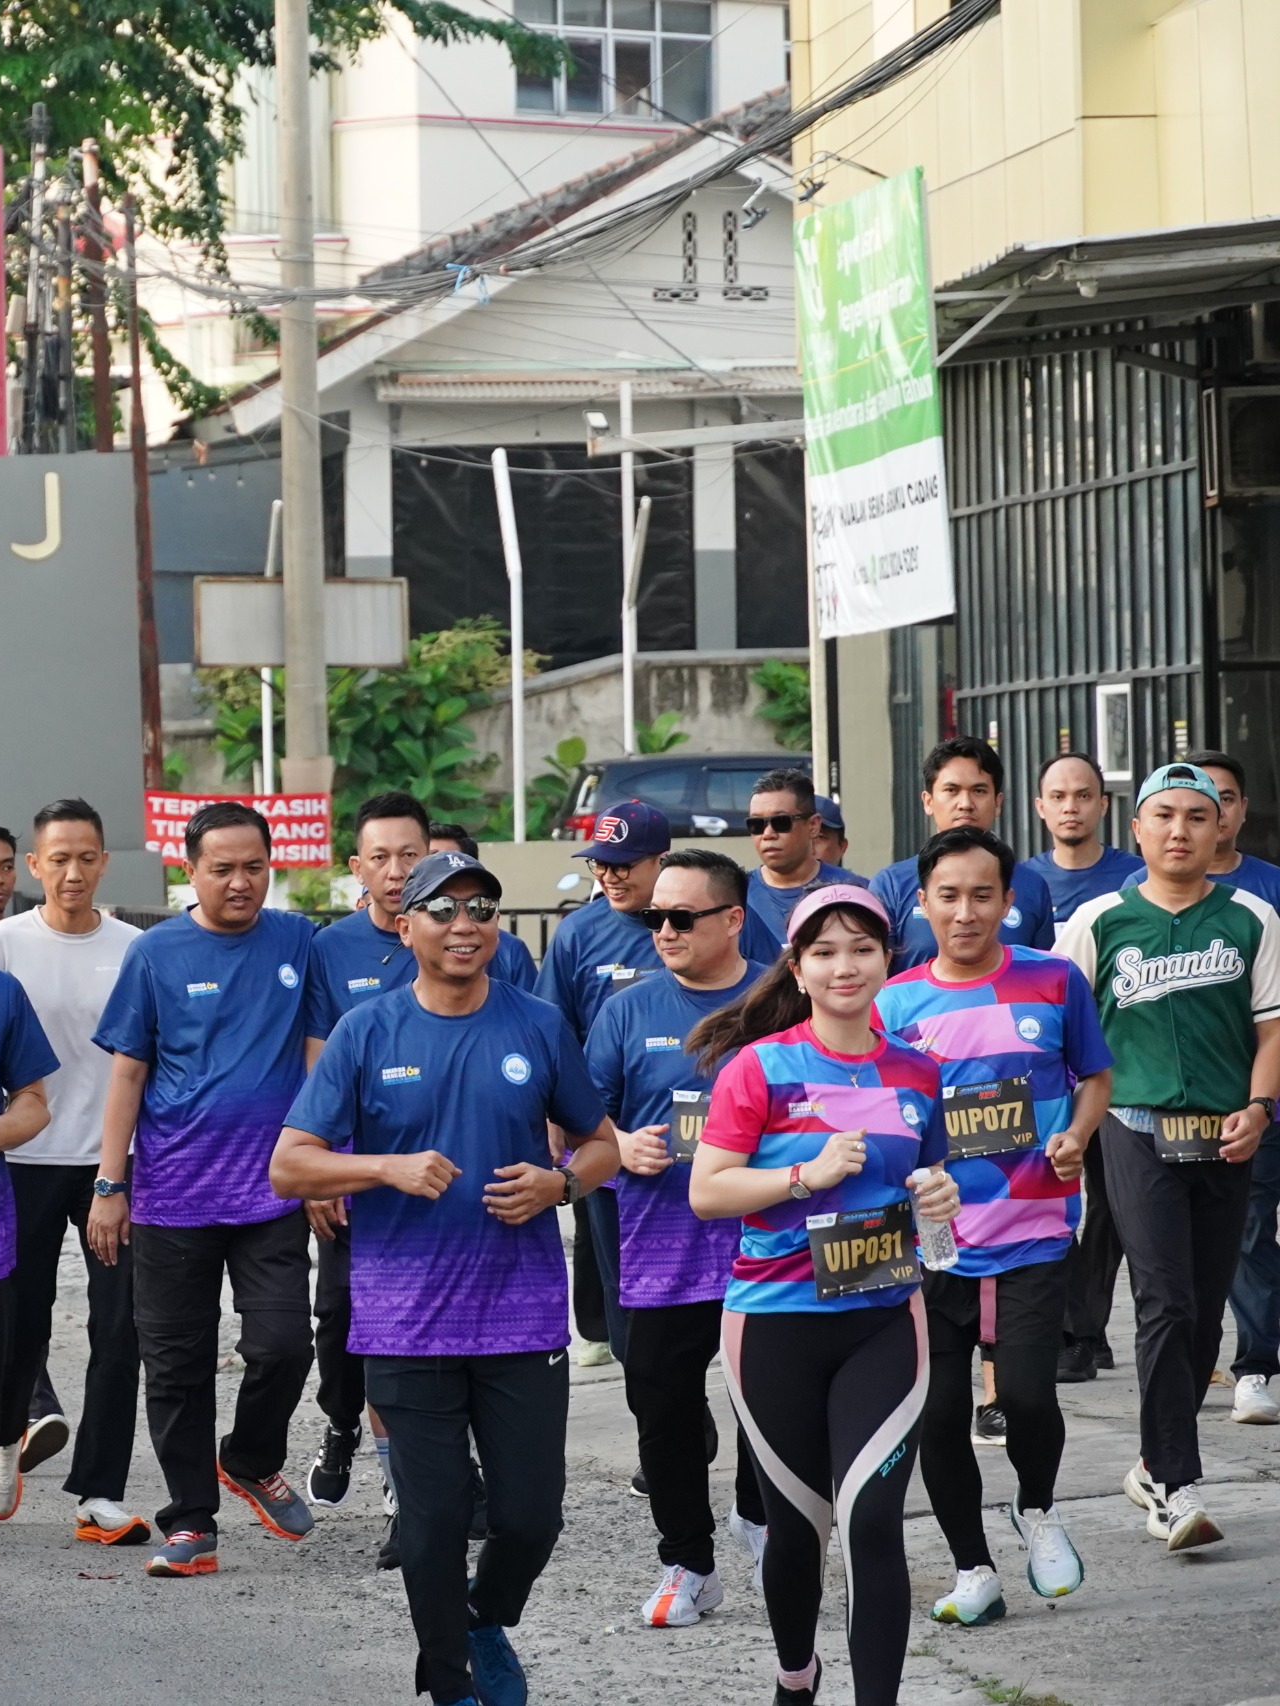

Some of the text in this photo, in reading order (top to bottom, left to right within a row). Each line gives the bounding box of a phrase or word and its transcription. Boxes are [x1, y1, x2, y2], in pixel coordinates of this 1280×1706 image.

[10, 471, 62, 561] J
[252, 799, 327, 816] KASIH
[268, 822, 326, 839] ANG
[446, 853, 466, 868] LA
[1113, 939, 1242, 1000] Smanda
[944, 1100, 1023, 1137] VIP077
[1012, 1132, 1033, 1144] VIP
[823, 1229, 903, 1273] VIP031
[890, 1265, 914, 1279] VIP
[879, 1442, 907, 1478] 2XU
